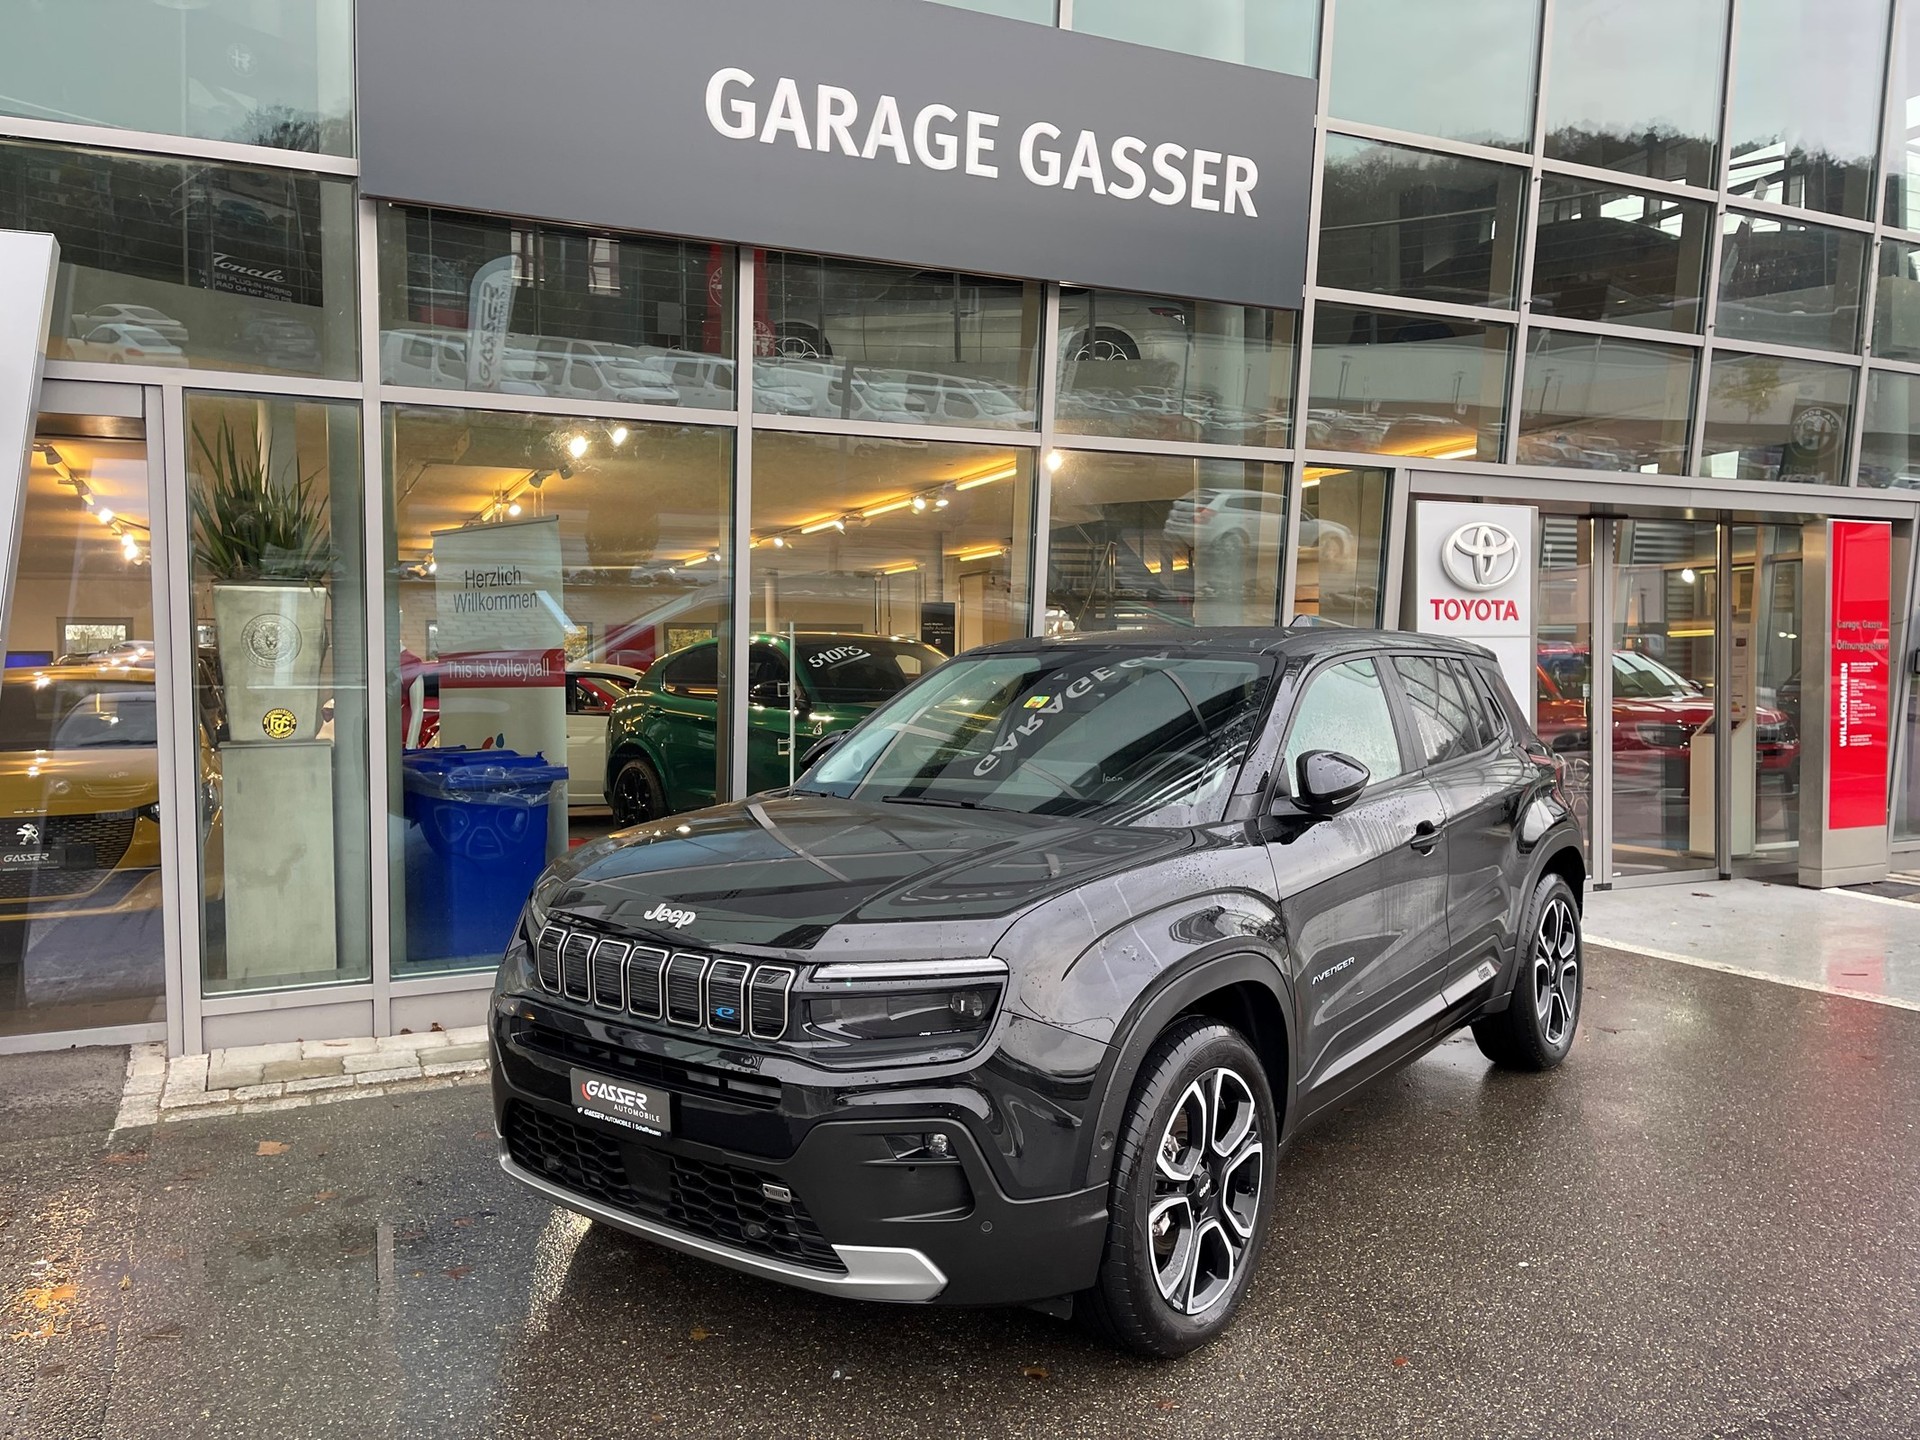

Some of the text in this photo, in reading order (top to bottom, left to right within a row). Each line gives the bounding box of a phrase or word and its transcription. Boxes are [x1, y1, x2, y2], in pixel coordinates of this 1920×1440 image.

[704, 67, 1259, 218] GARAGE GASSER
[212, 251, 286, 283] Tonale
[464, 565, 522, 589] Herzlich
[453, 591, 538, 613] Willkommen
[1430, 598, 1520, 621] TOYOTA
[808, 645, 864, 668] 510PS
[446, 657, 550, 682] This is Volleyball
[1839, 662, 1849, 747] WILLKOMMEN
[3, 852, 50, 863] GASSER
[643, 903, 697, 929] Jeep
[1311, 956, 1356, 986] AVENGER
[586, 1080, 648, 1111] GASSER
[584, 1108, 605, 1120] GASSER
[604, 1115, 632, 1128] AUTOMOBILE
[613, 1104, 661, 1123] AUTOMOBILE
